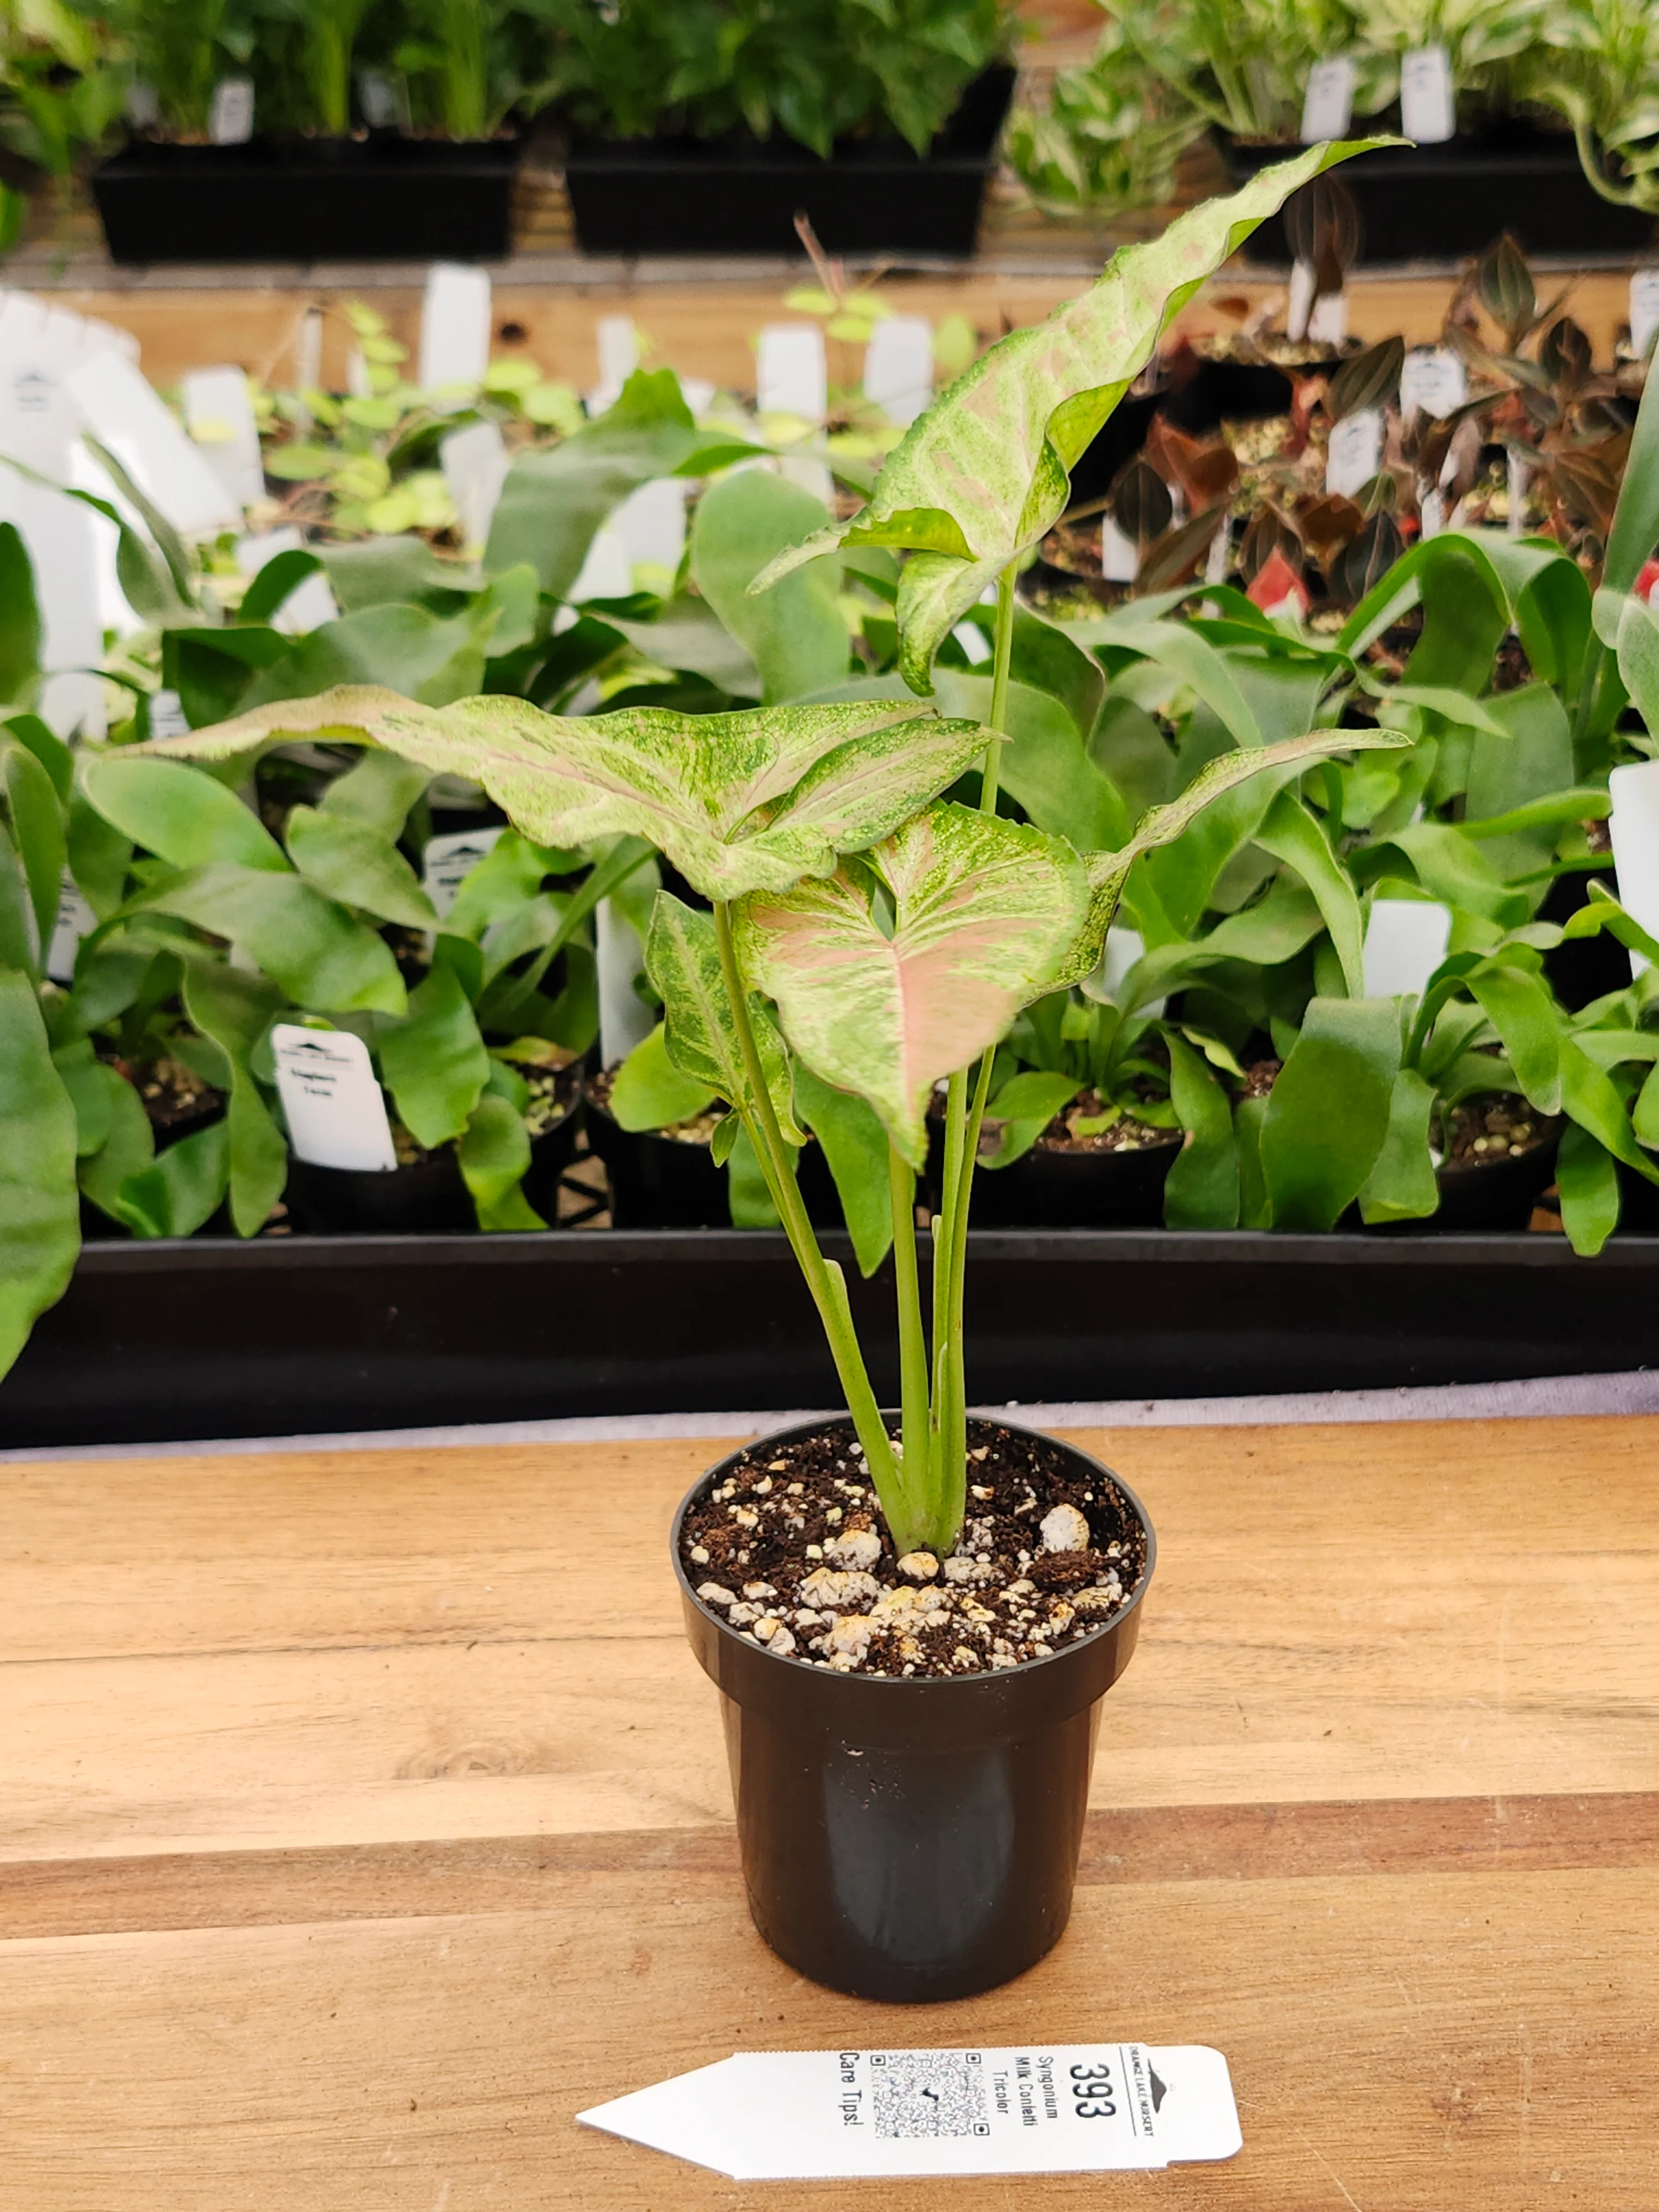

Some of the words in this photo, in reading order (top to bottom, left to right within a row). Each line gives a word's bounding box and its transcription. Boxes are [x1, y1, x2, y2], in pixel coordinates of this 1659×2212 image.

[839, 2052, 860, 2083] Care
[1014, 2057, 1032, 2079] Milk
[1129, 2046, 1143, 2076] ORANGE
[993, 2070, 1011, 2114] Tricolor
[1019, 2084, 1039, 2126] Confetti
[1036, 2056, 1058, 2119] Syngonium
[1070, 2063, 1117, 2119] 393
[1135, 2078, 1147, 2098] LAKE
[838, 2089, 864, 2126] Tips!
[1139, 2099, 1154, 2137] NURSERY
